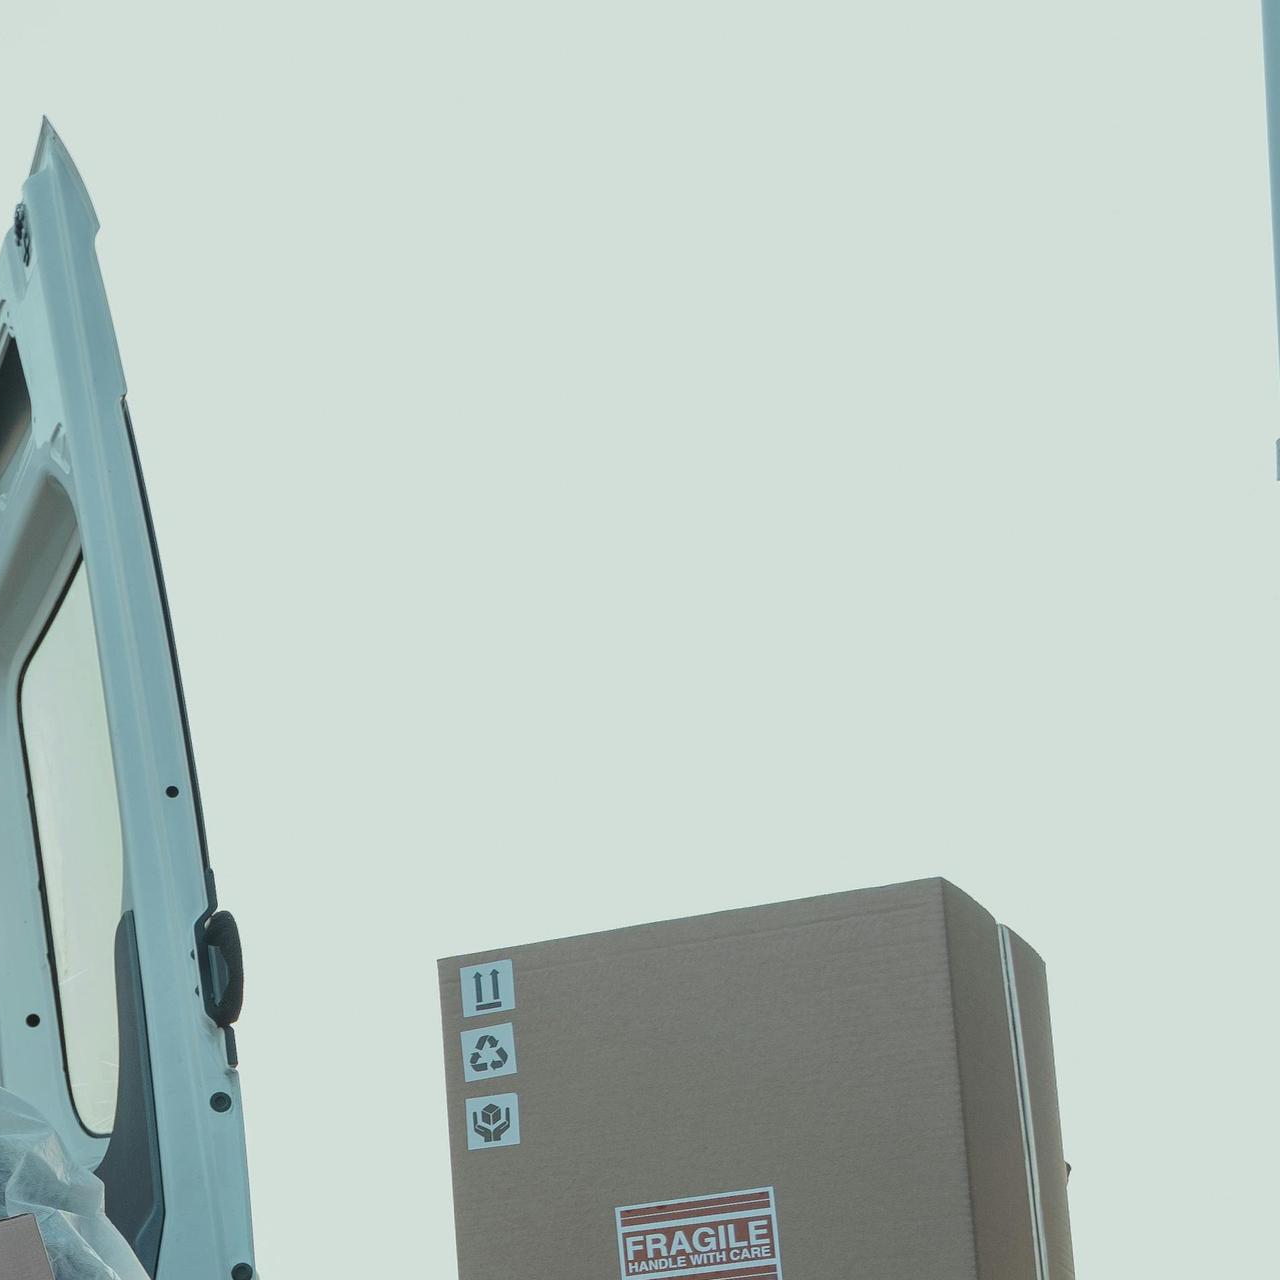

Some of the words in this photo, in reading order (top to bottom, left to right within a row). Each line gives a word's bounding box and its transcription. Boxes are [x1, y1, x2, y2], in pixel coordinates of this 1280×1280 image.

[625, 1220, 770, 1261] FRAGILE
[628, 1256, 687, 1273] HANDLE
[690, 1251, 726, 1265] WITH
[730, 1246, 771, 1261] CARE
